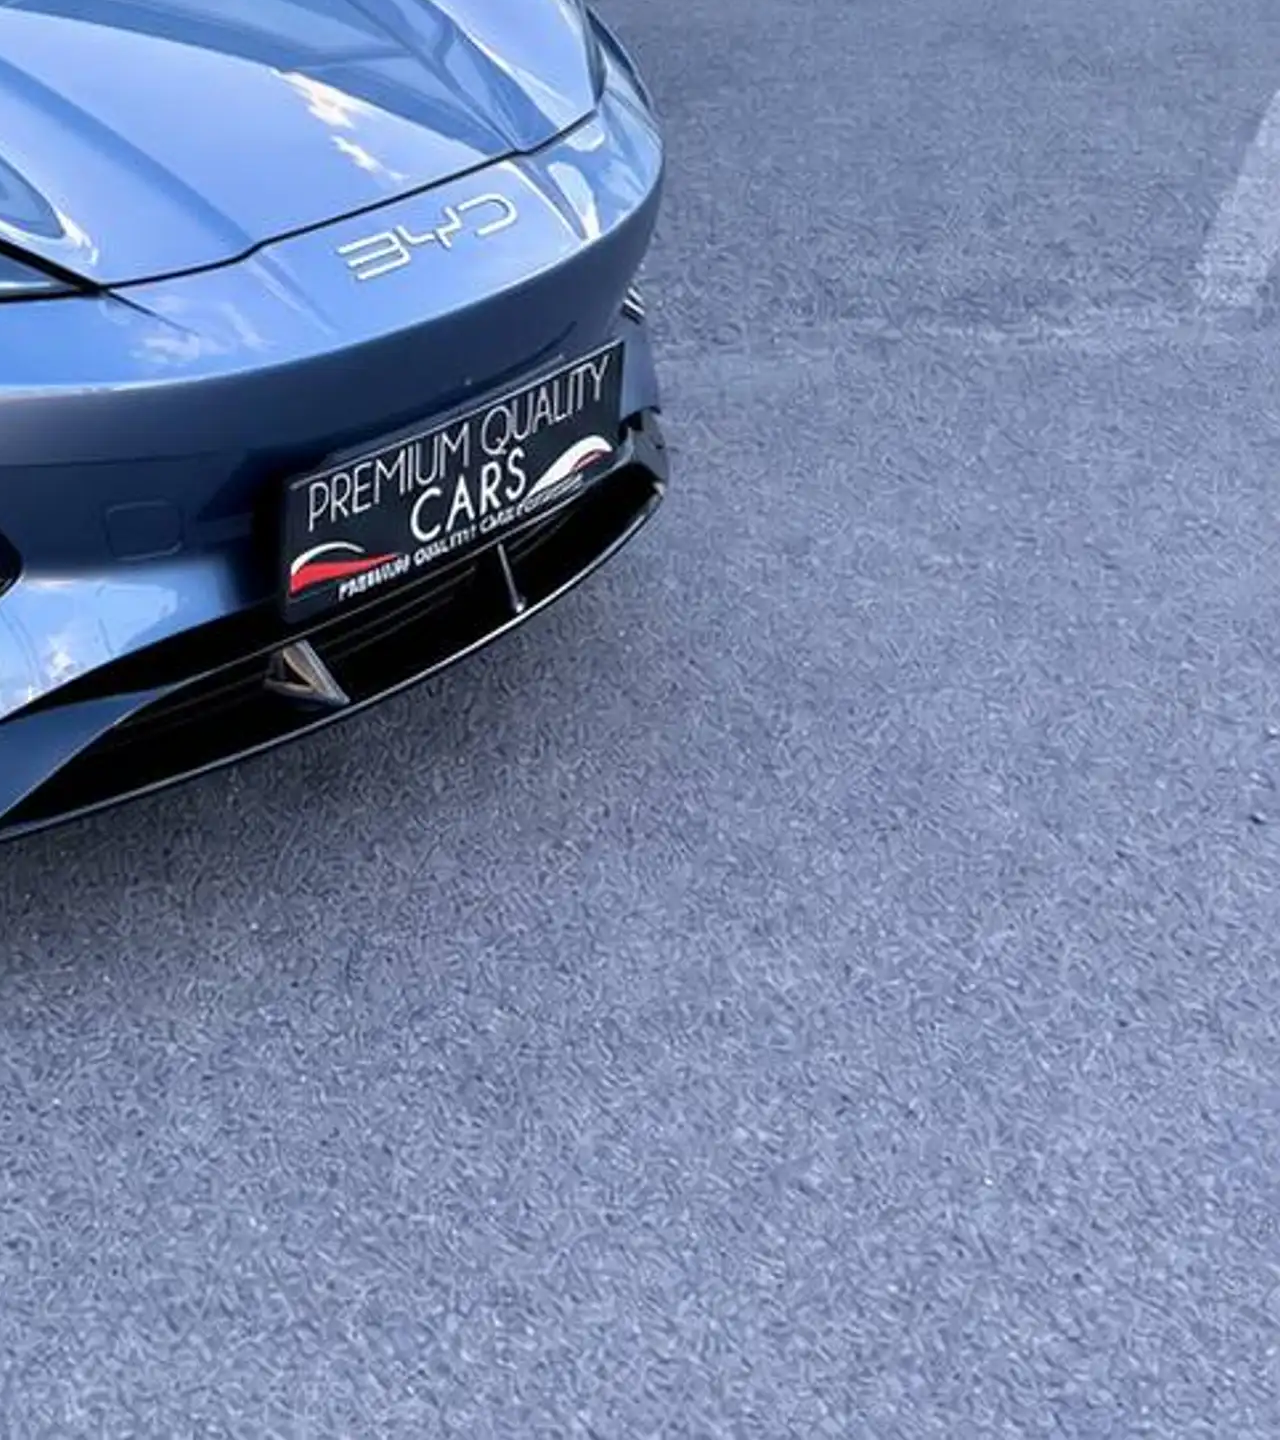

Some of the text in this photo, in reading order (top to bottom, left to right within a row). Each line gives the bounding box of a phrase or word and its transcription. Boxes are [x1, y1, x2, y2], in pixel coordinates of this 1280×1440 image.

[336, 192, 518, 280] BYD
[308, 422, 470, 533] PREMIUM
[481, 355, 611, 457] QUALITY
[410, 447, 527, 542] CARS
